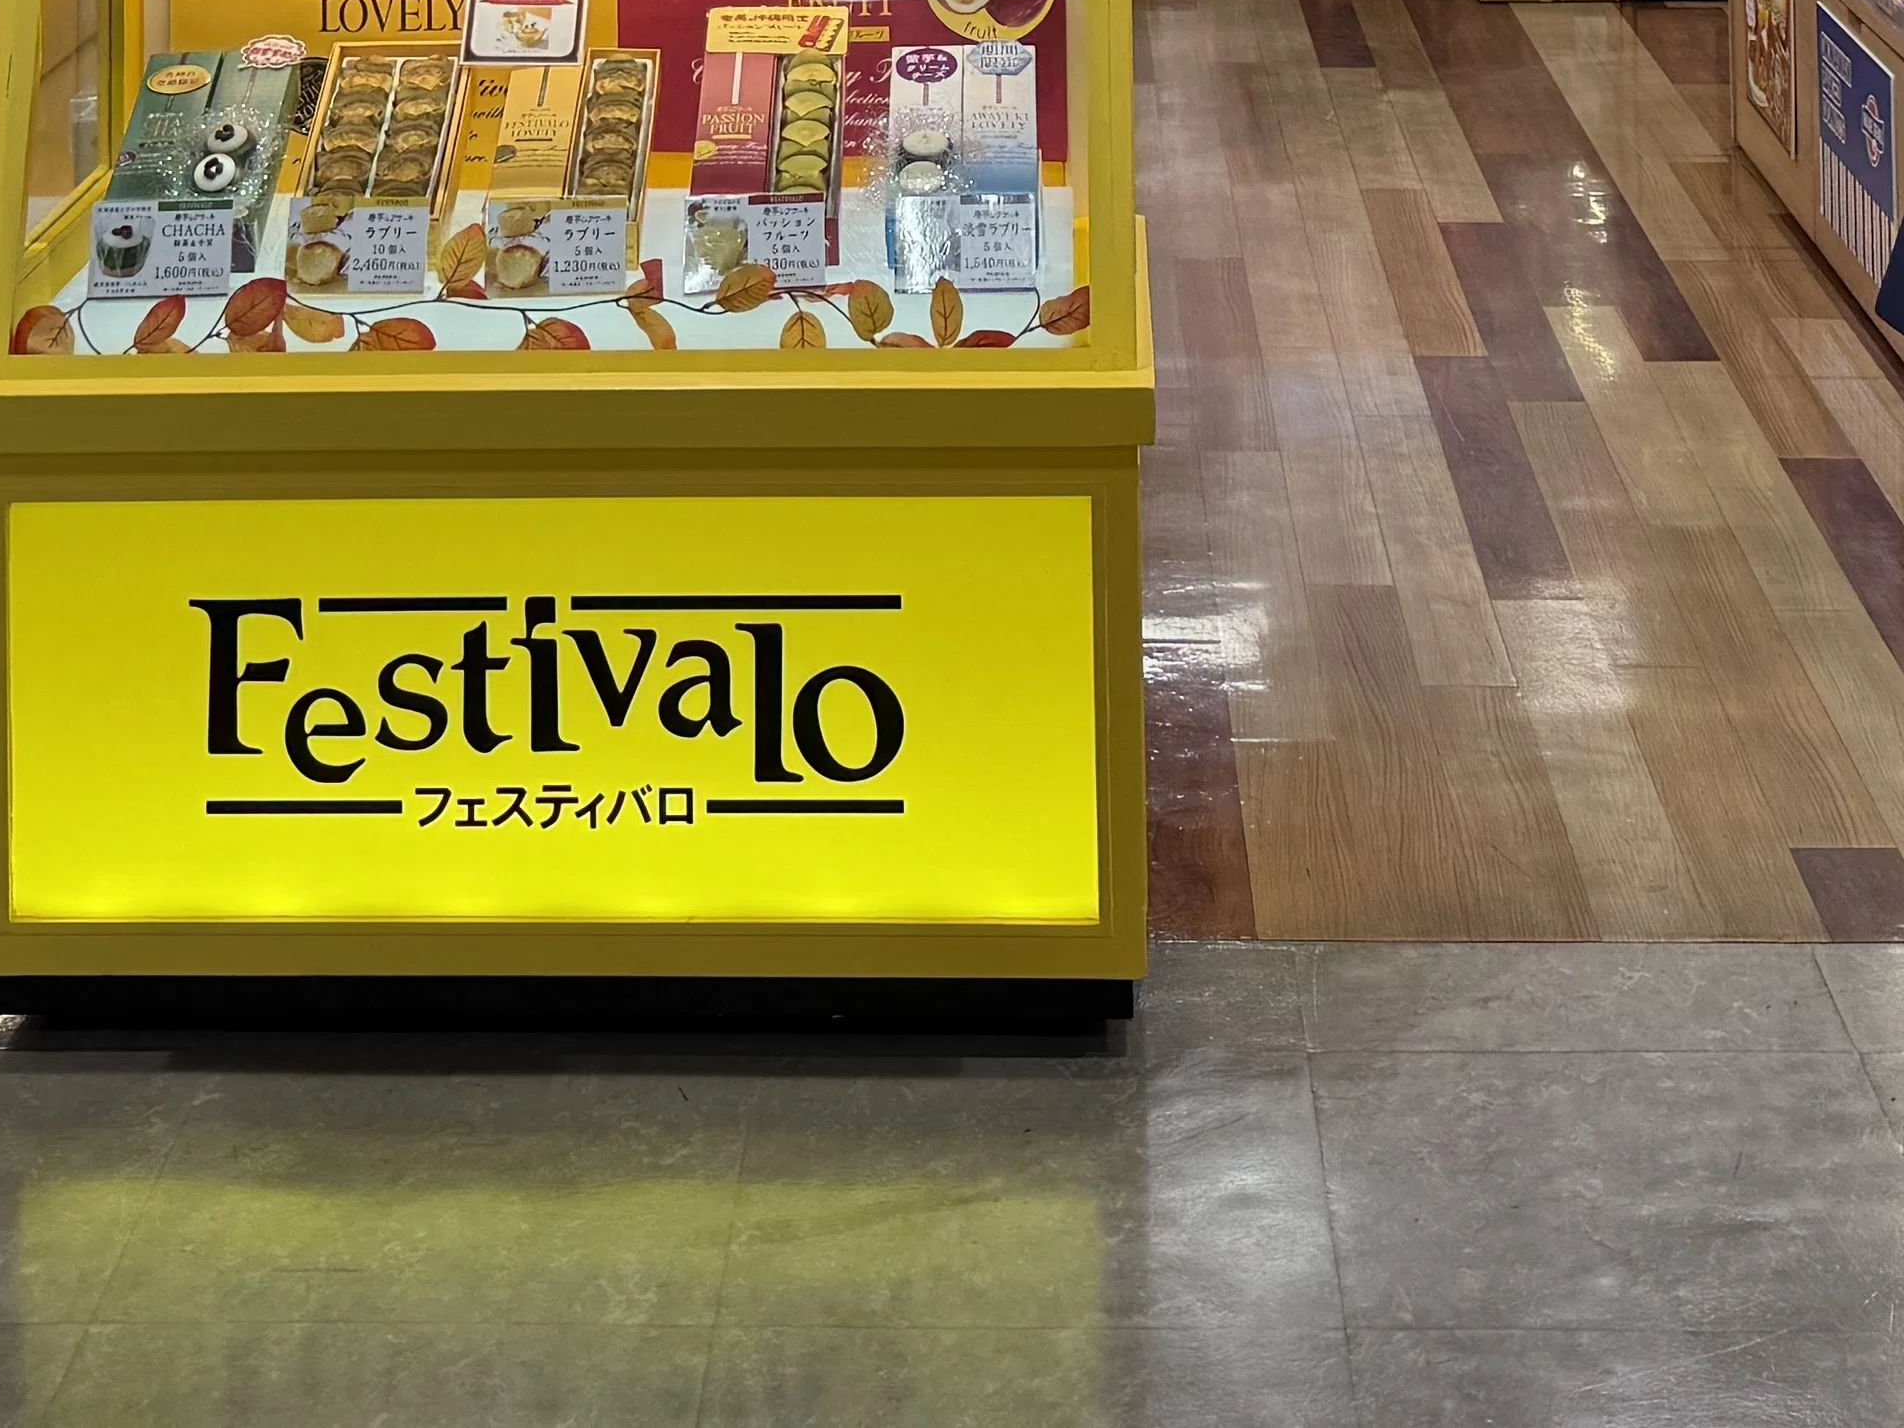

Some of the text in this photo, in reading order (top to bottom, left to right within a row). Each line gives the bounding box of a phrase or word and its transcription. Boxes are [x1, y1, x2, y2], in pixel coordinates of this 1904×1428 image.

[161, 224, 226, 238] CHACHA
[189, 595, 904, 783] Festivalo
[415, 785, 694, 829] フェスティバロ
